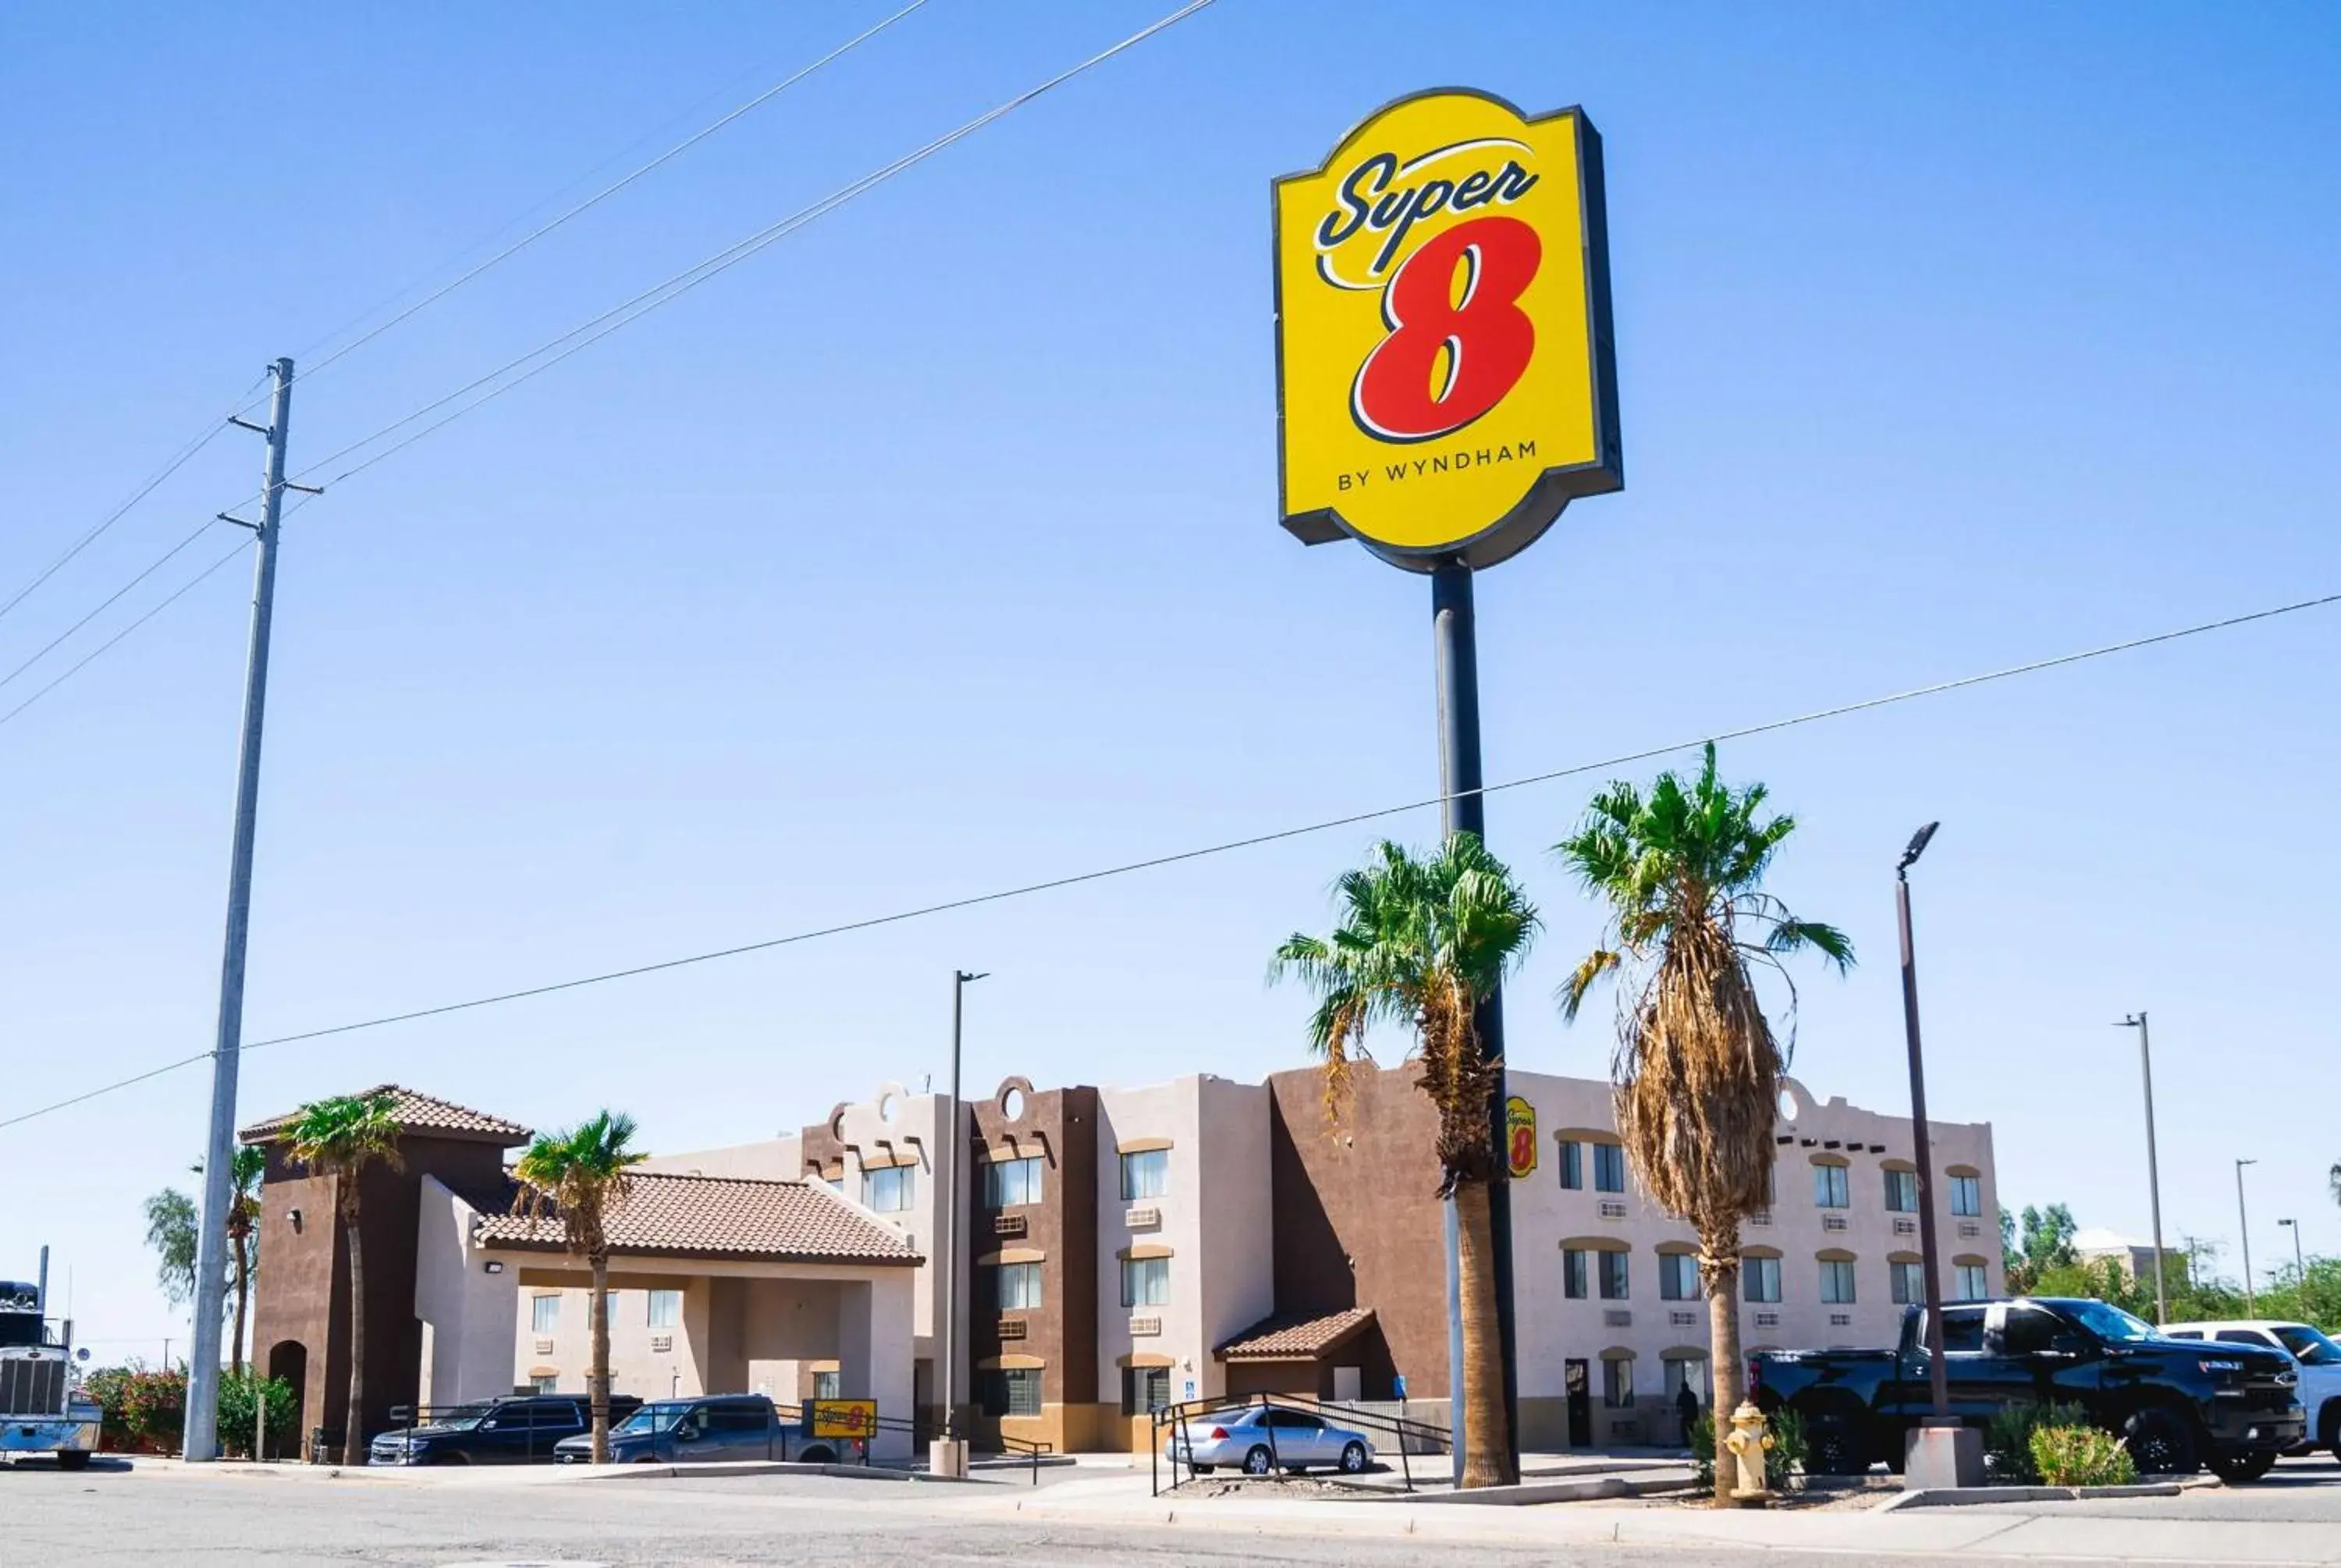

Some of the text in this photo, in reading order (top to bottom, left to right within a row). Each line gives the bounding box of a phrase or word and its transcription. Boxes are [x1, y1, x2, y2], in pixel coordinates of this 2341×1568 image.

[1315, 151, 1540, 275] Super
[1349, 216, 1541, 444] 8
[1338, 441, 1536, 491] BY WYNDHAM
[1511, 1127, 1533, 1169] 8
